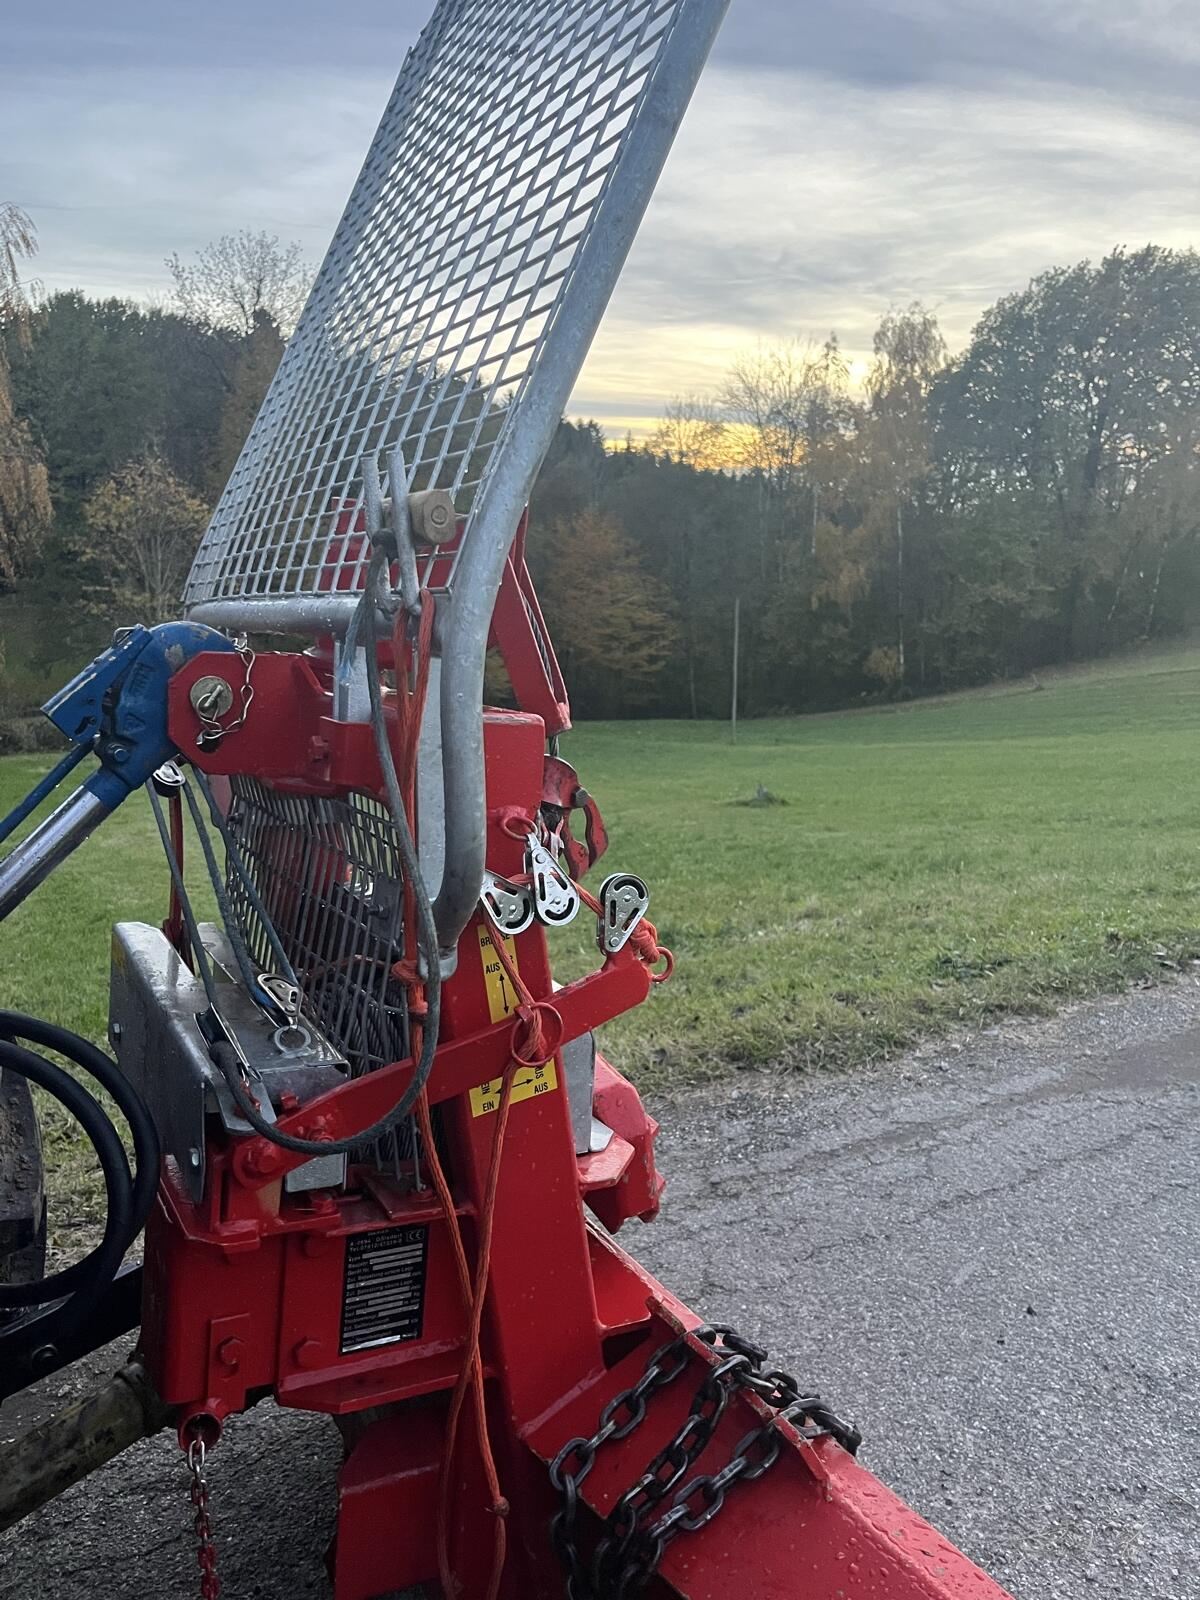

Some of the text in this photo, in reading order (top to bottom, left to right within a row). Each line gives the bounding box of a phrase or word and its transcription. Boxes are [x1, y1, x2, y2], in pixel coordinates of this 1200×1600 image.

[480, 934, 510, 947] BRSE
[485, 962, 501, 974] AUS
[534, 1082, 548, 1094] AUS
[482, 1100, 494, 1112] EIN
